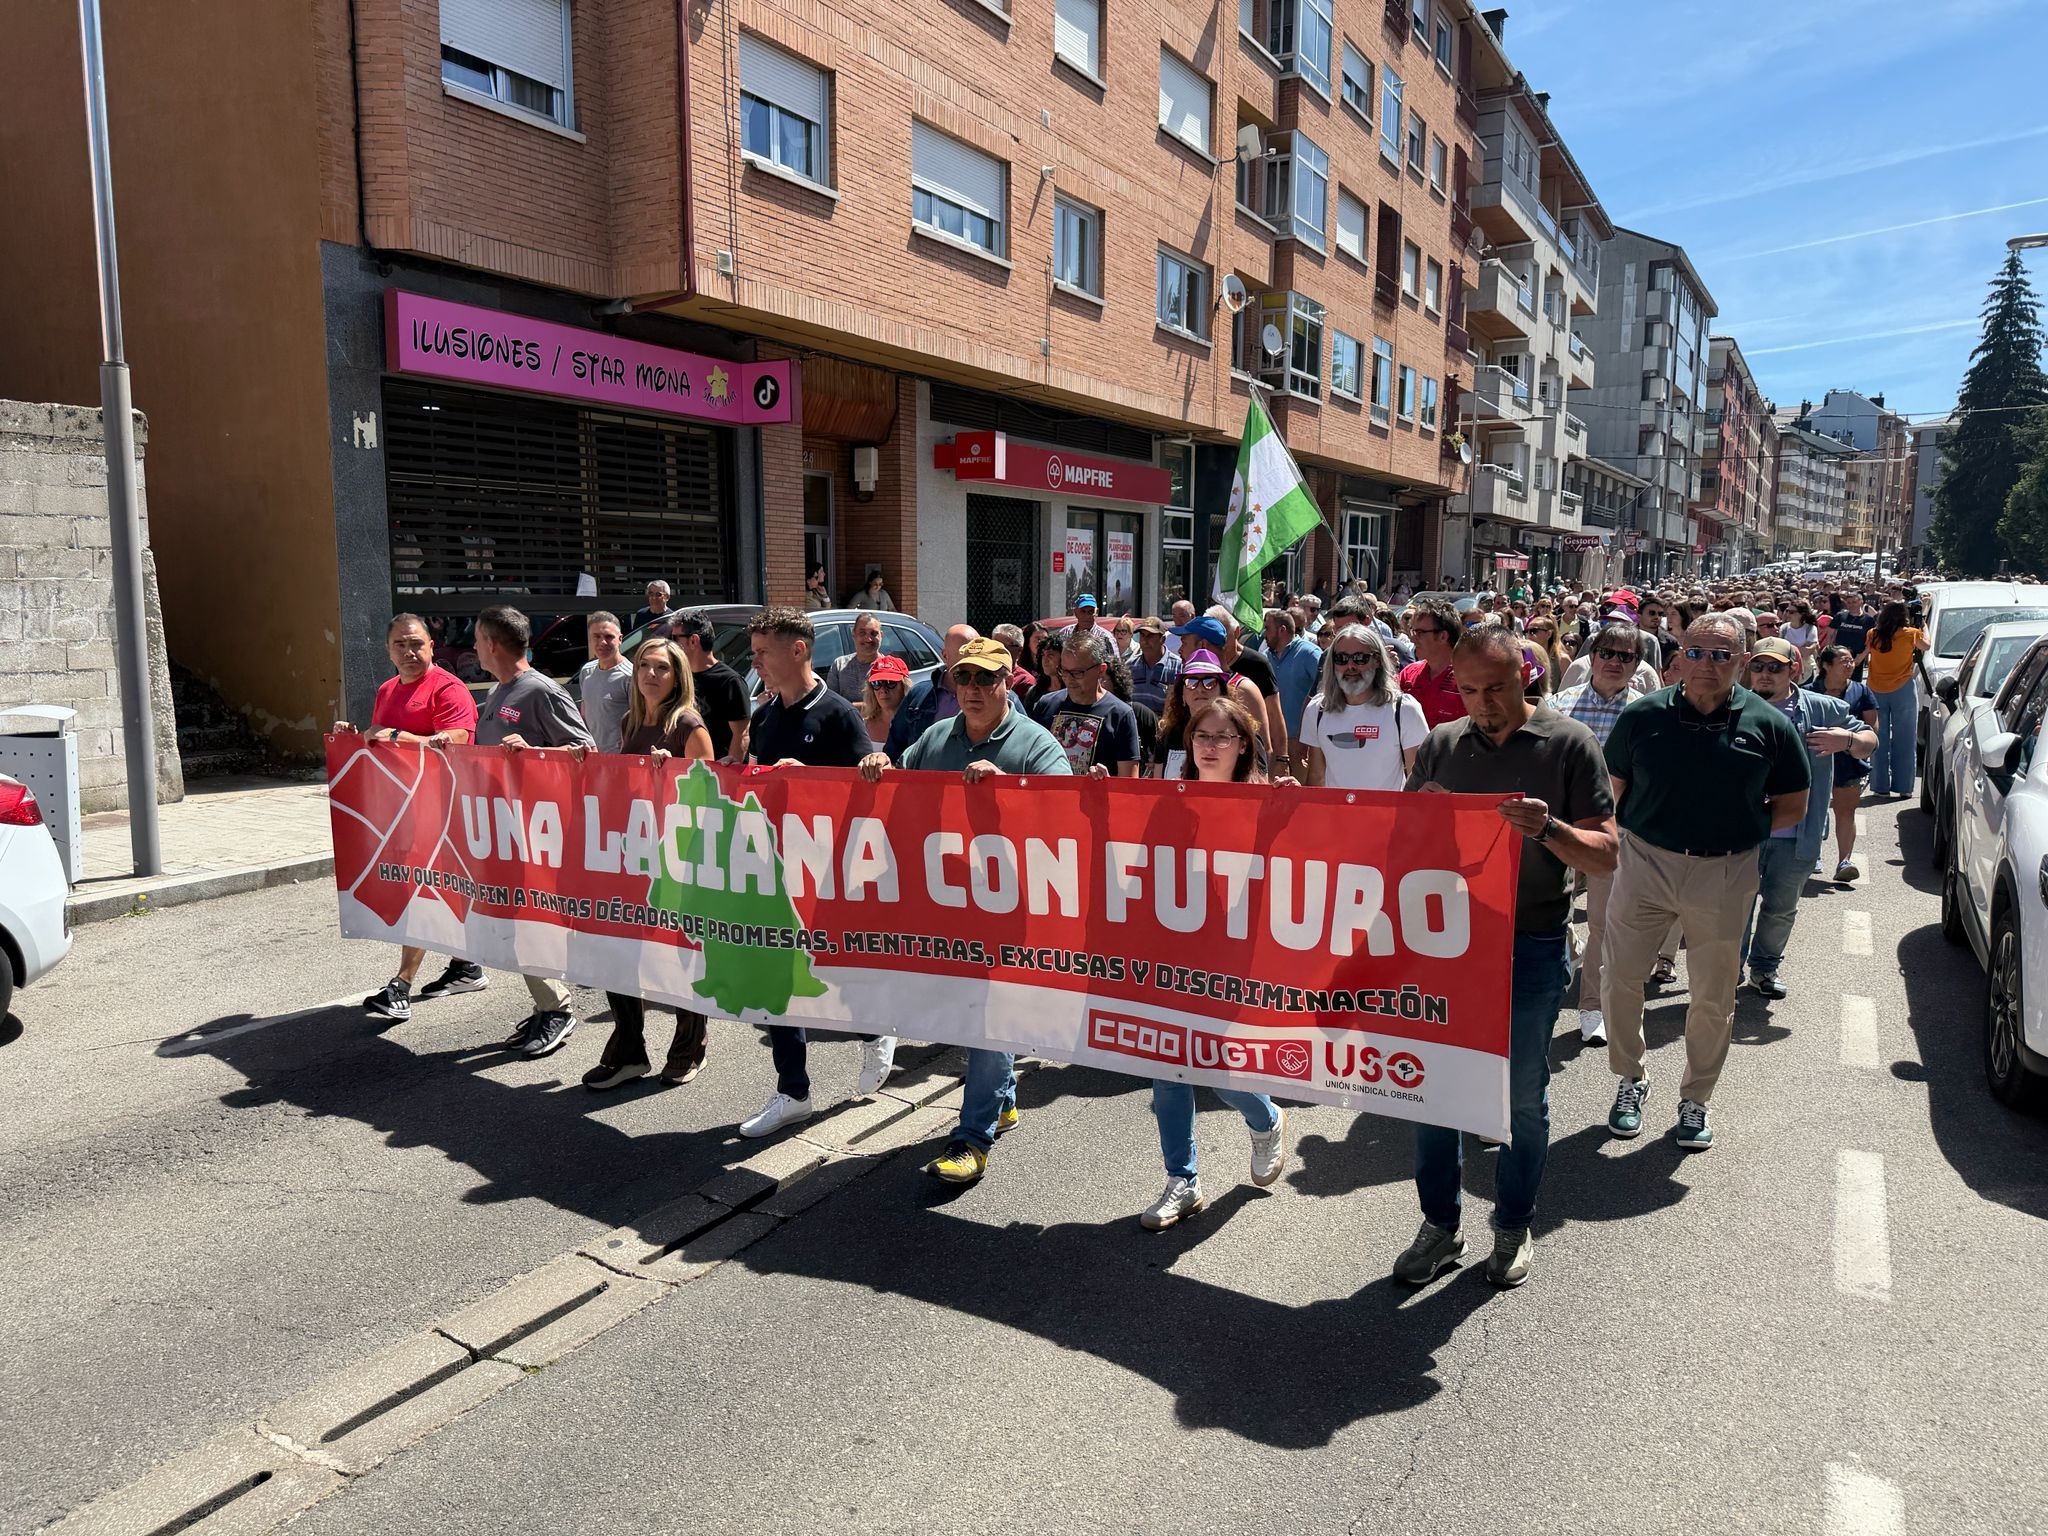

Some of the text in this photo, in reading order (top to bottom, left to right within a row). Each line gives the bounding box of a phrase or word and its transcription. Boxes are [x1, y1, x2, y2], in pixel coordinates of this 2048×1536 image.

[413, 318, 541, 371] ILUSIONES
[572, 351, 626, 387] STAR
[636, 363, 691, 398] MONA
[1065, 465, 1113, 488] MAPFRE
[1067, 541, 1074, 554] DE
[1564, 536, 1599, 545] Gestoría
[500, 706, 521, 718] CCOO
[461, 794, 1471, 959] UNA LACIANA CON FUTURO
[379, 863, 1449, 1024] HAY QUE PONER FIN A TANTAS DÉCADAS DE PROMESAS, MENTIRAS, EXCUSAS Y DISCRIMINACIÓN
[1094, 1017, 1425, 1089] CCOO UGT USO
[1325, 1080, 1425, 1104] UNIÓN SINDICAL OBRERA
